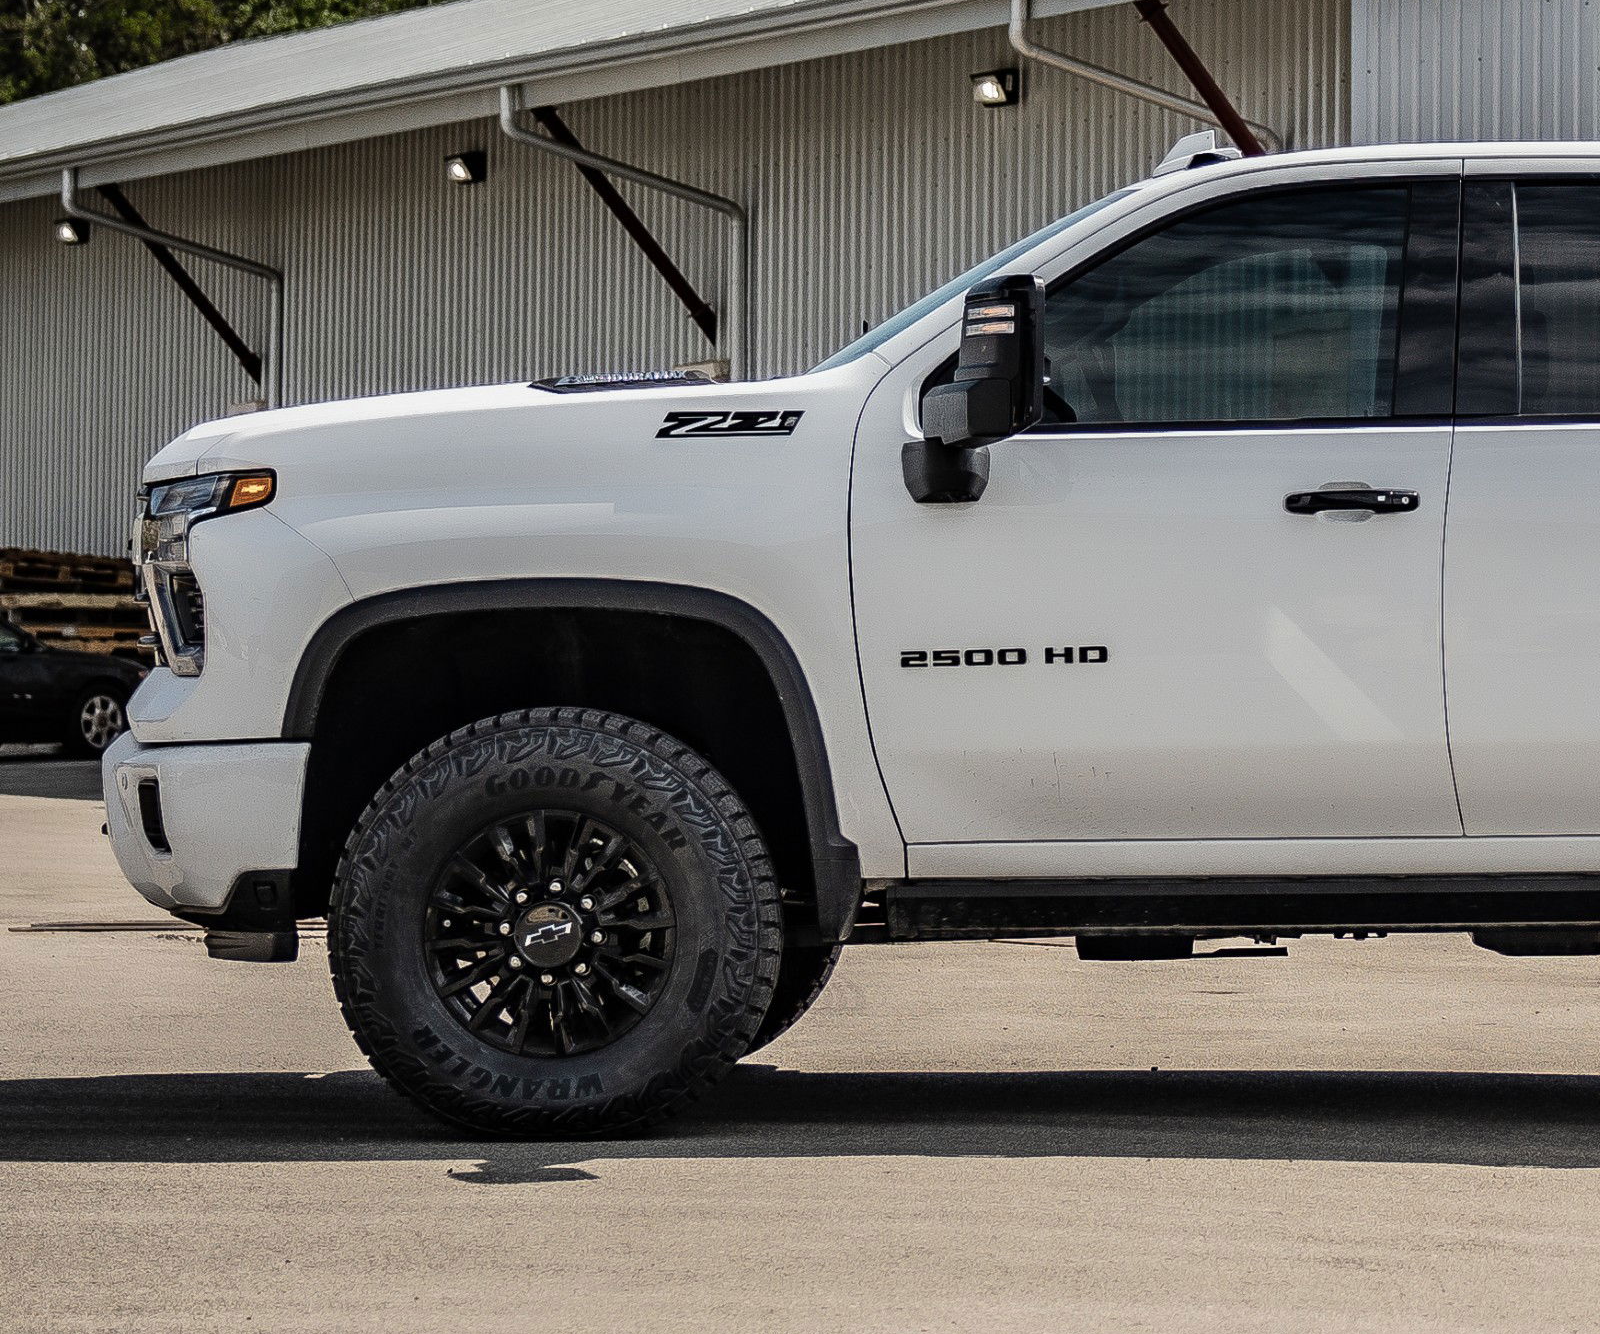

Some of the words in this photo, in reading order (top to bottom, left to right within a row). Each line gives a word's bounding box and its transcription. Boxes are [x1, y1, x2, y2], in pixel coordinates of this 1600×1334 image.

[655, 410, 806, 438] Z71
[900, 647, 1027, 668] 2500
[1044, 645, 1109, 665] HD
[484, 766, 687, 851] GOODYEAR
[411, 1024, 606, 1100] WRANGLER
